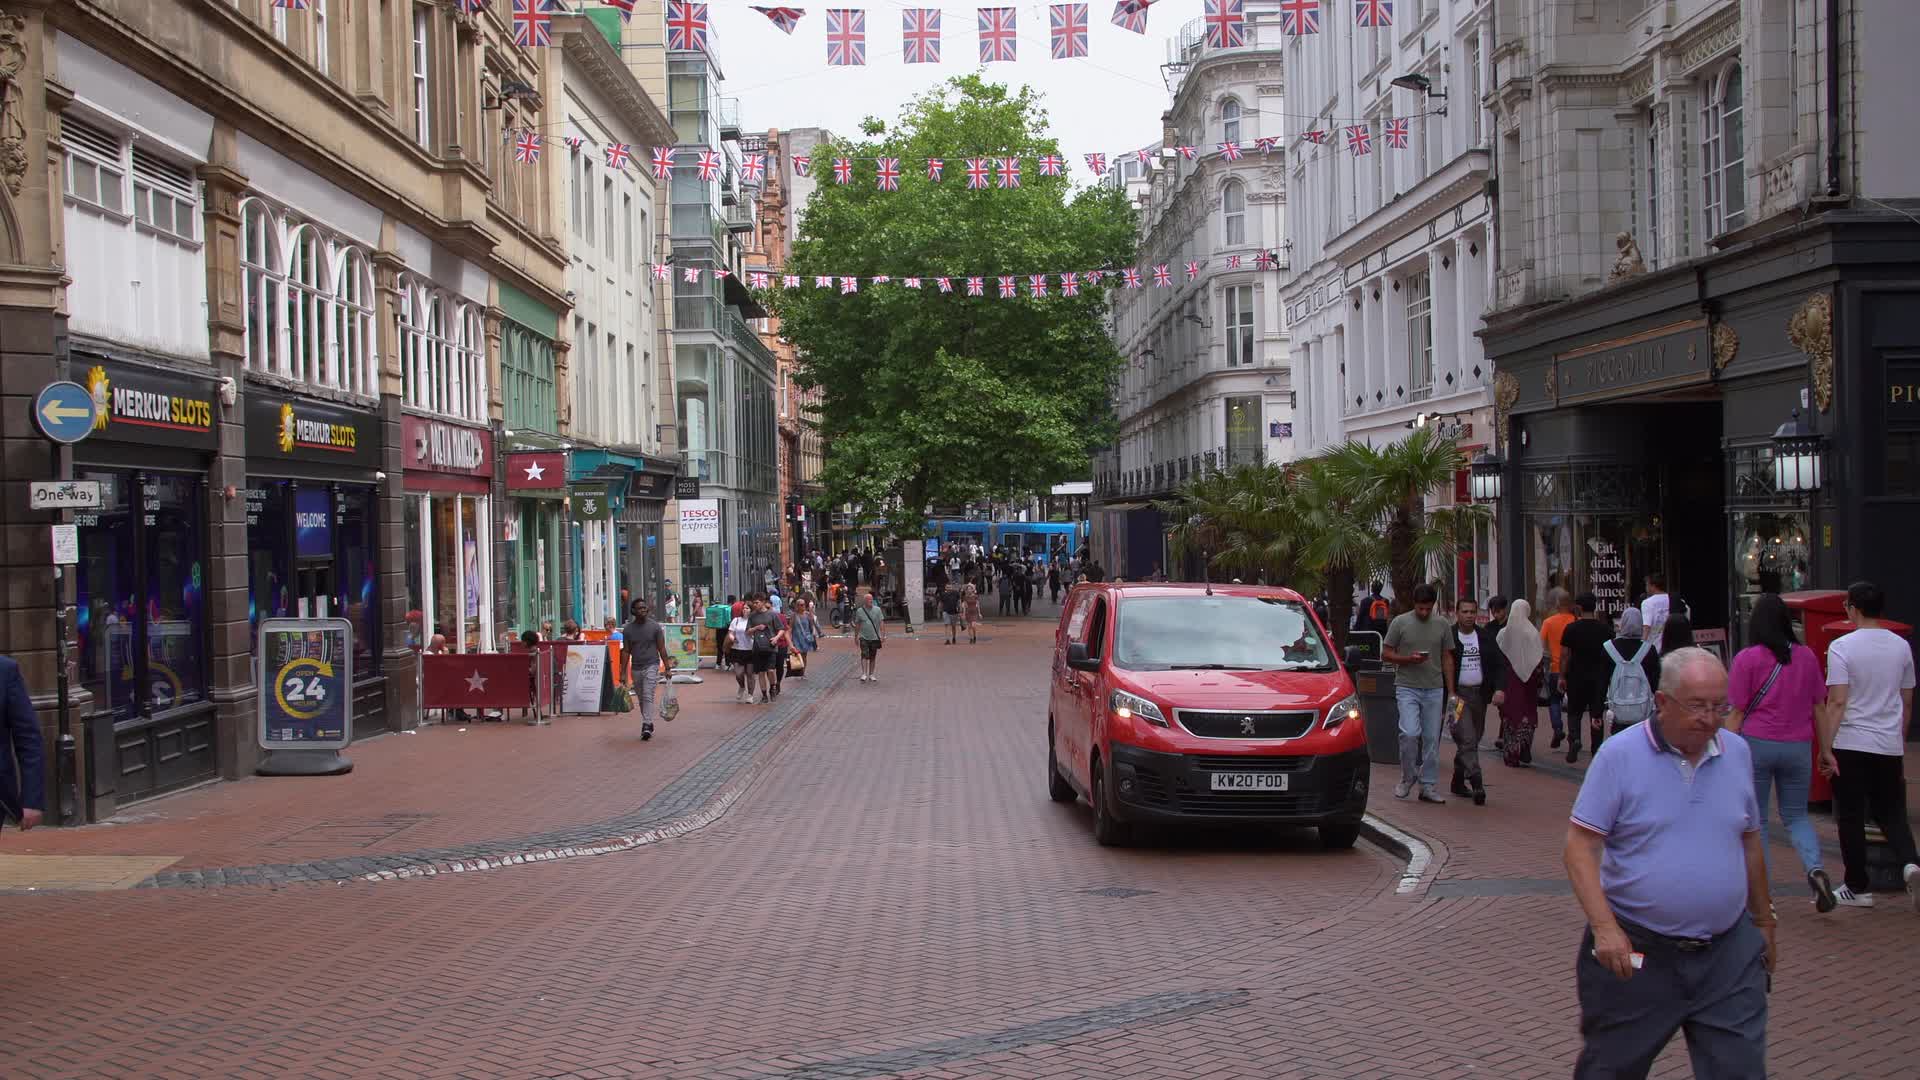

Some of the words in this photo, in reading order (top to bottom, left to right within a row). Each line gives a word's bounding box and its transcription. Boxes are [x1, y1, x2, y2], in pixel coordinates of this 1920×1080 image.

[1585, 344, 1665, 385] PICCADILLY
[113, 387, 170, 422] MERKUR
[171, 398, 211, 427] SLOTS
[296, 419, 331, 444] MERKUR
[331, 424, 356, 447] SLOTS
[37, 488, 64, 501] One
[69, 490, 93, 502] way
[296, 512, 327, 528] WELCOME
[682, 510, 717, 518] TESCO
[682, 521, 719, 532] express
[1595, 541, 1617, 554] Eat,
[1590, 570, 1625, 583] shoot,
[1591, 584, 1625, 598] dance
[285, 677, 326, 701] 24
[1218, 774, 1253, 788] KW20
